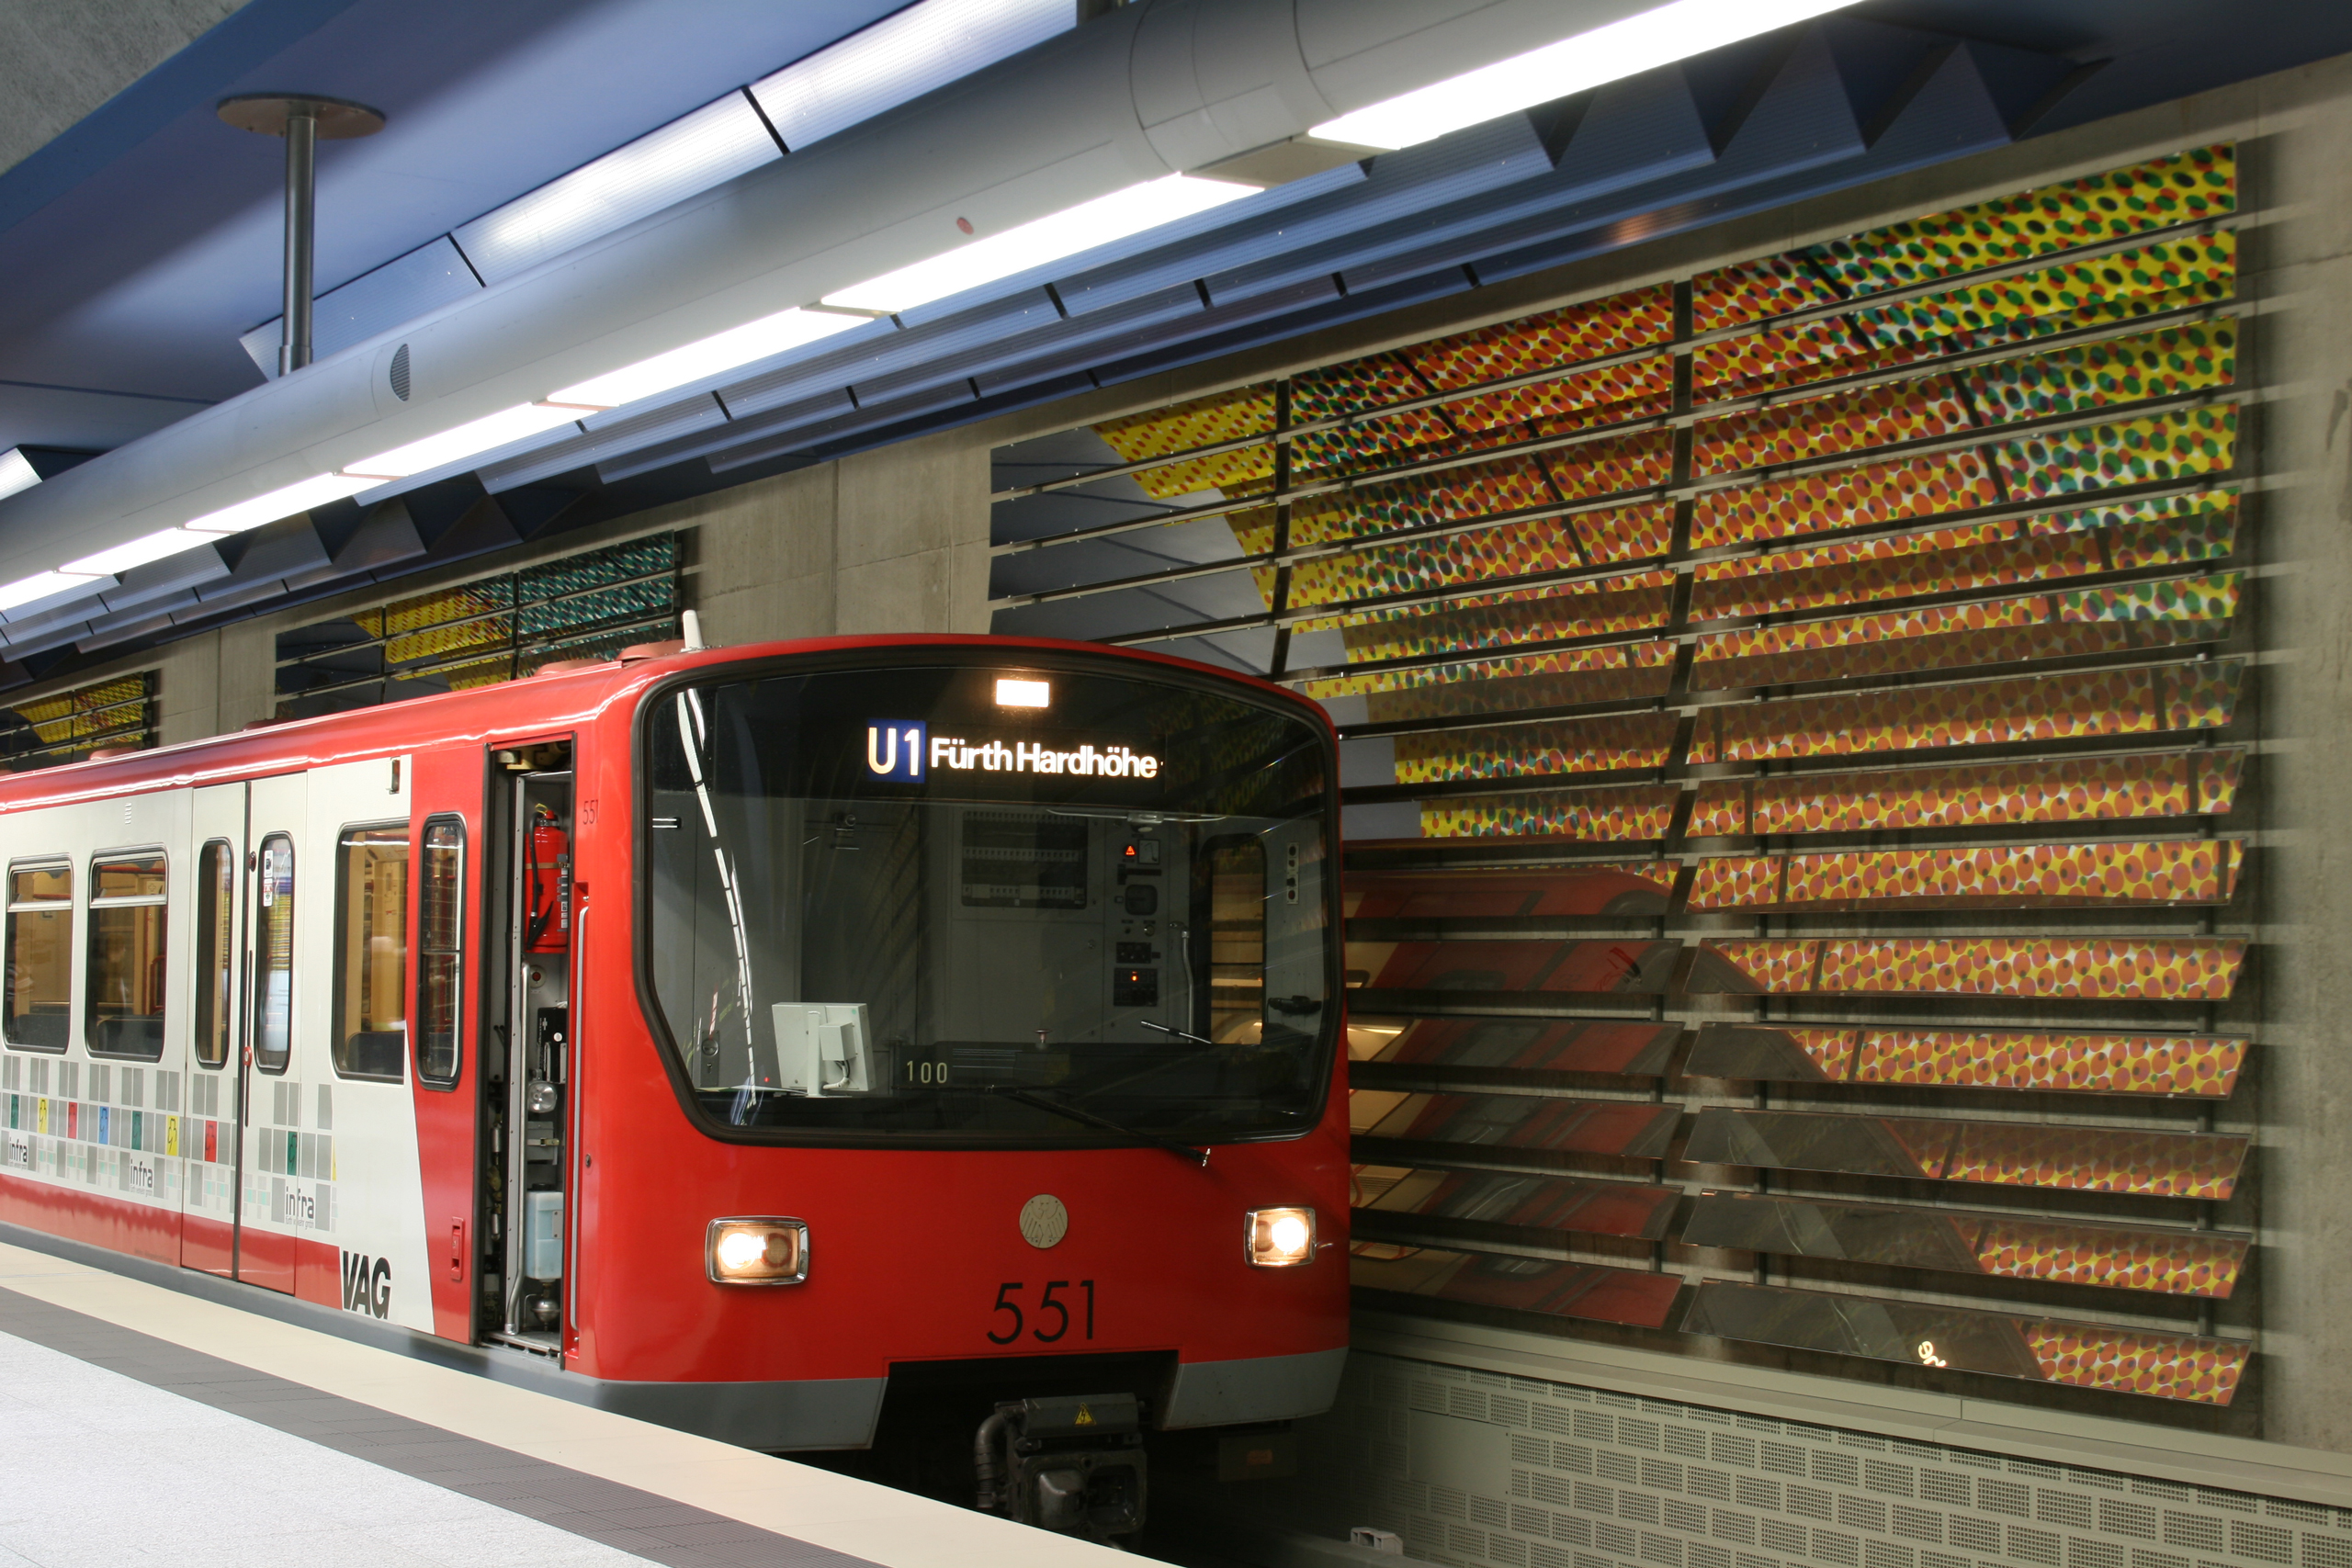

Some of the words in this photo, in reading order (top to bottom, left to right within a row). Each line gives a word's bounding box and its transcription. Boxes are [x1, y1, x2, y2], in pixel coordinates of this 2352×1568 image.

[868, 727, 920, 776] U1
[931, 737, 1013, 772] Fürth
[1016, 741, 1158, 778] Hardhöhe
[582, 798, 598, 825] 551
[906, 1060, 948, 1084] 100
[8, 1136, 28, 1163] infra
[130, 1159, 153, 1189] infra
[285, 1185, 315, 1220] infra
[343, 1249, 391, 1320] VAG
[986, 1279, 1094, 1346] 551
